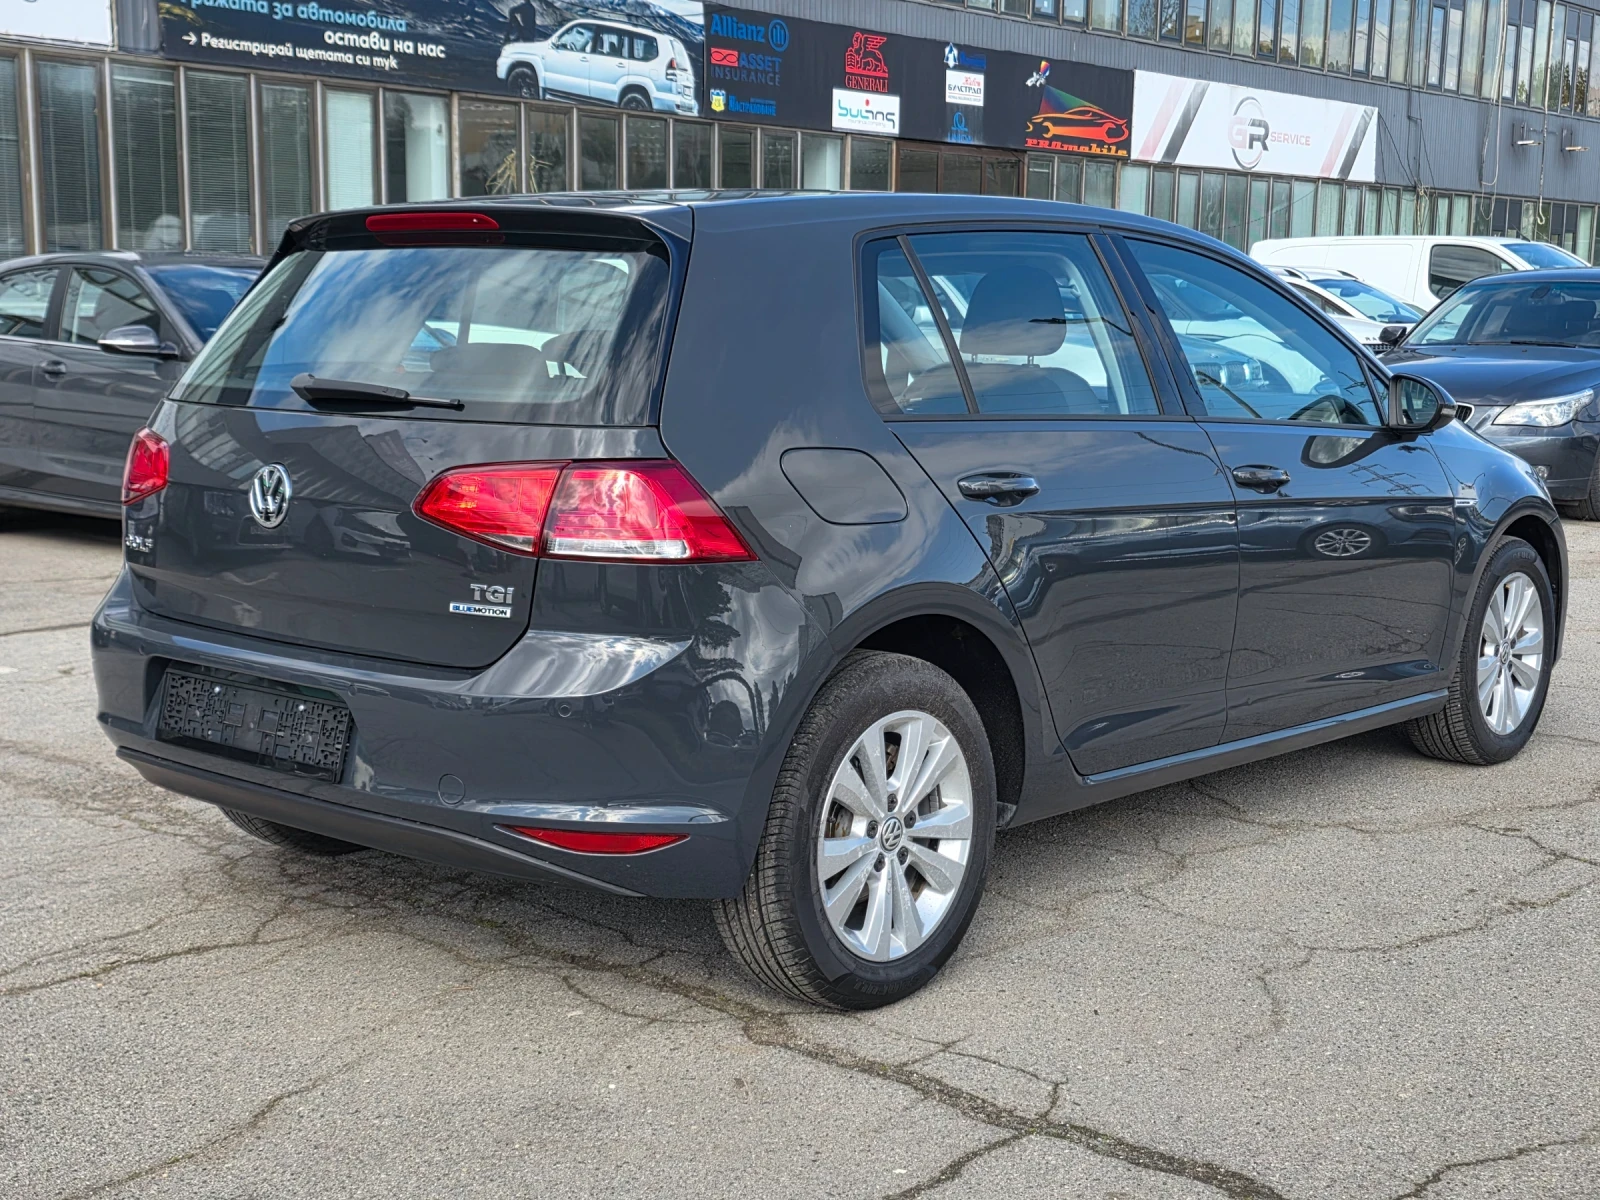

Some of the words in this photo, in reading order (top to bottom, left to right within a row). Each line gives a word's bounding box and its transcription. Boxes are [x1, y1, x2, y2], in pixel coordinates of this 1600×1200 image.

[181, 0, 269, 14] рижата
[272, 2, 293, 20] за
[296, 1, 408, 32] автомобила
[710, 13, 766, 43] Allianz
[201, 32, 294, 57] Регистрирай
[295, 46, 354, 63] щетата
[355, 54, 371, 66] си
[372, 54, 399, 71] тук
[323, 30, 390, 51] остави
[393, 39, 415, 54] на
[417, 42, 446, 58] нас
[740, 52, 782, 72] ASSET
[710, 65, 781, 86] INSURANCE
[845, 74, 889, 93] GENERALI
[1270, 131, 1311, 146] SERVICE
[451, 604, 508, 616] BLUEMOTION
